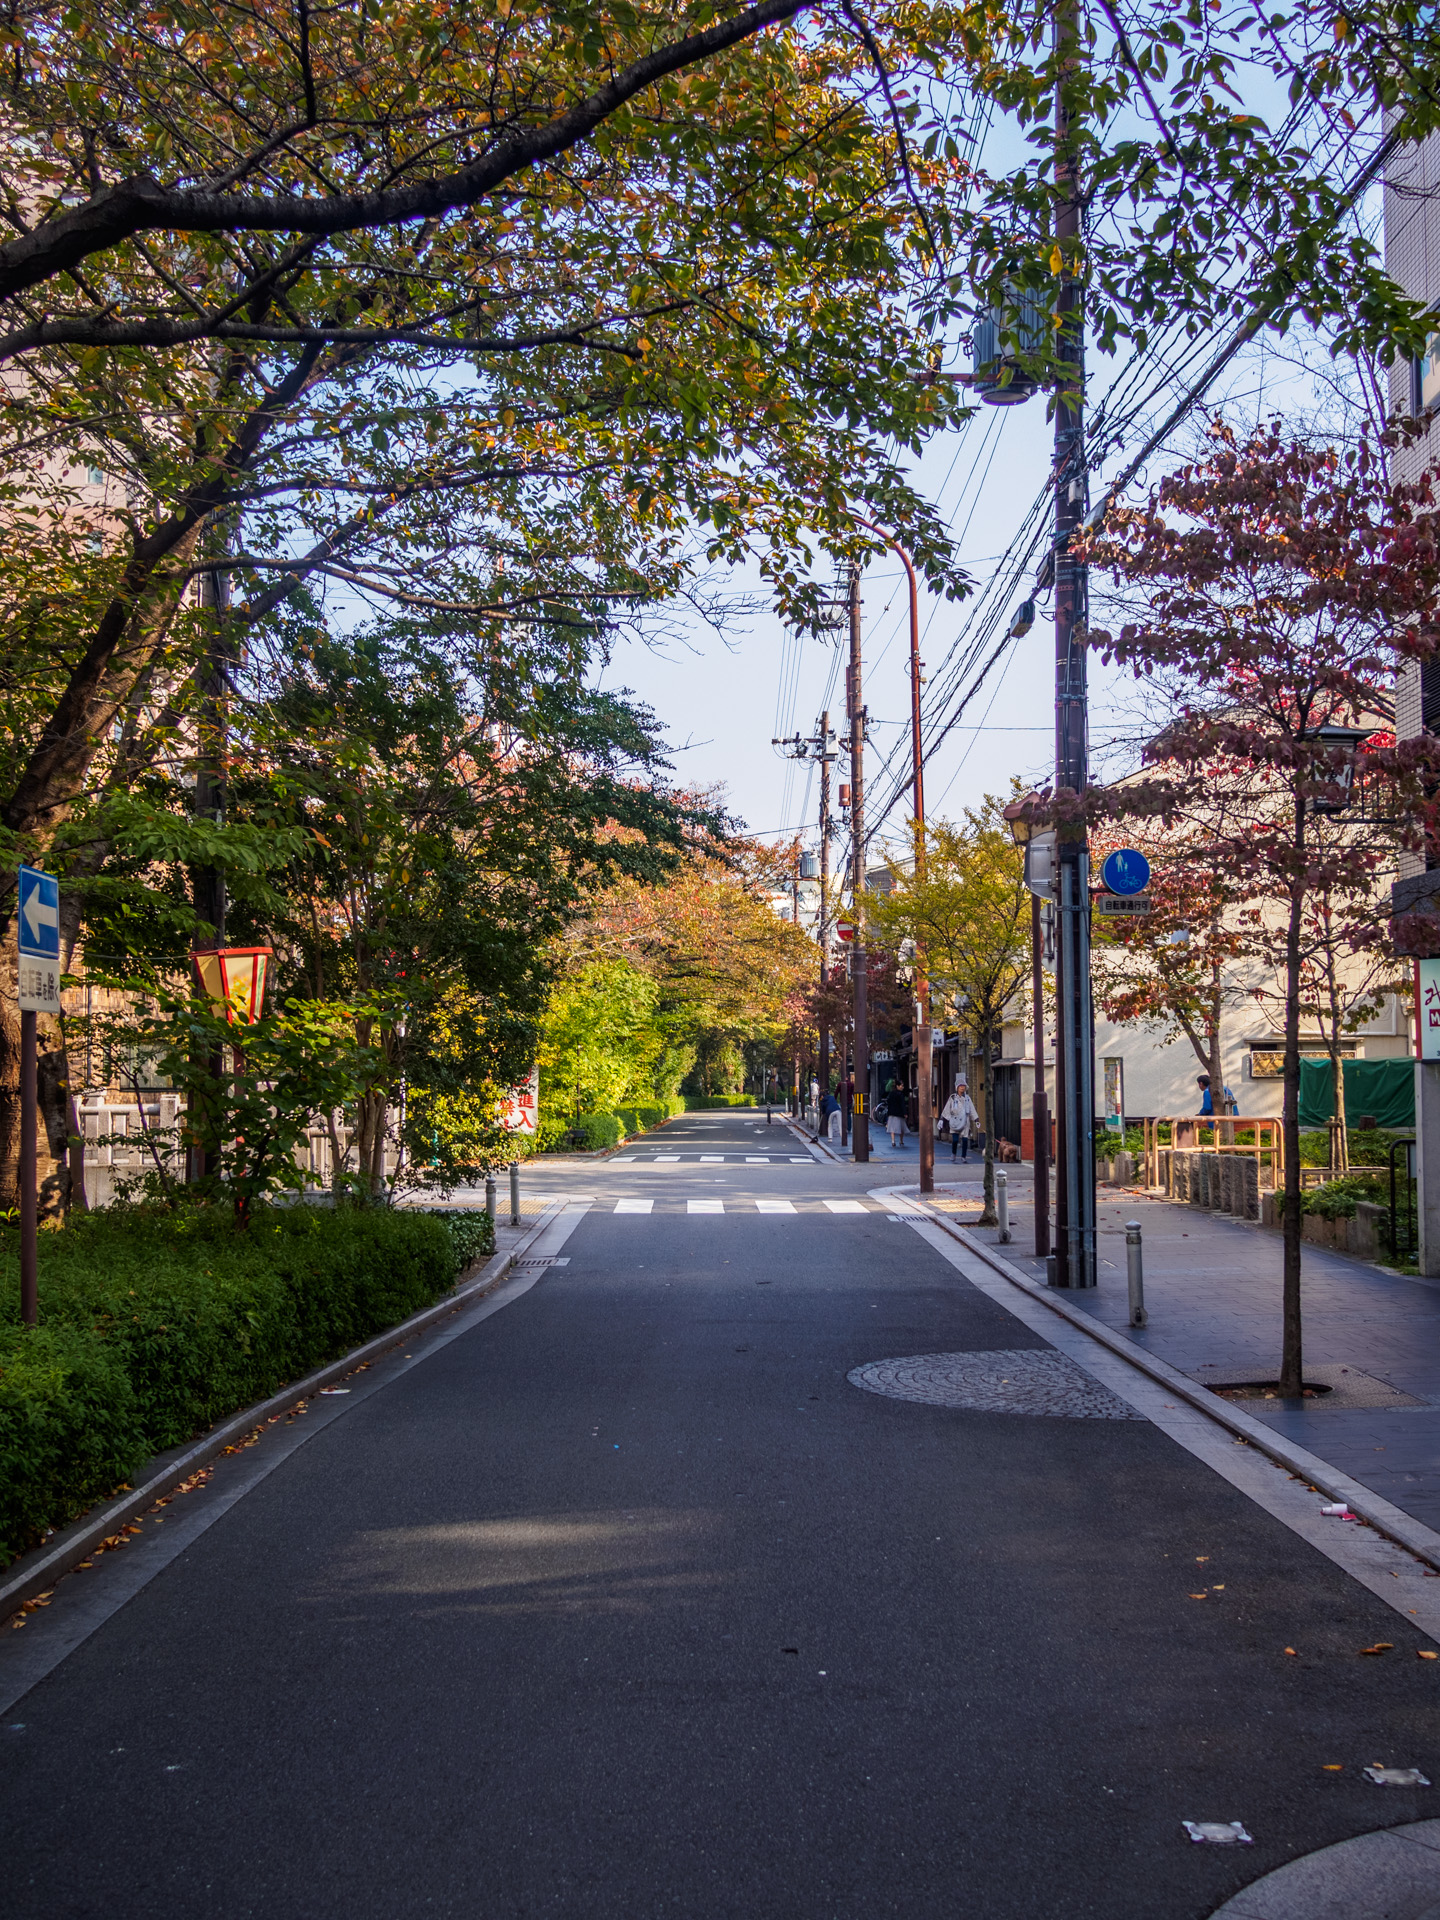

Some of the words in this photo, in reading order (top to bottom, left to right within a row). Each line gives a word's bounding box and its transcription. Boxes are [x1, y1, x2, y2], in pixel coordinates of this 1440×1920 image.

[1105, 900, 1149, 911] 自転車通行可
